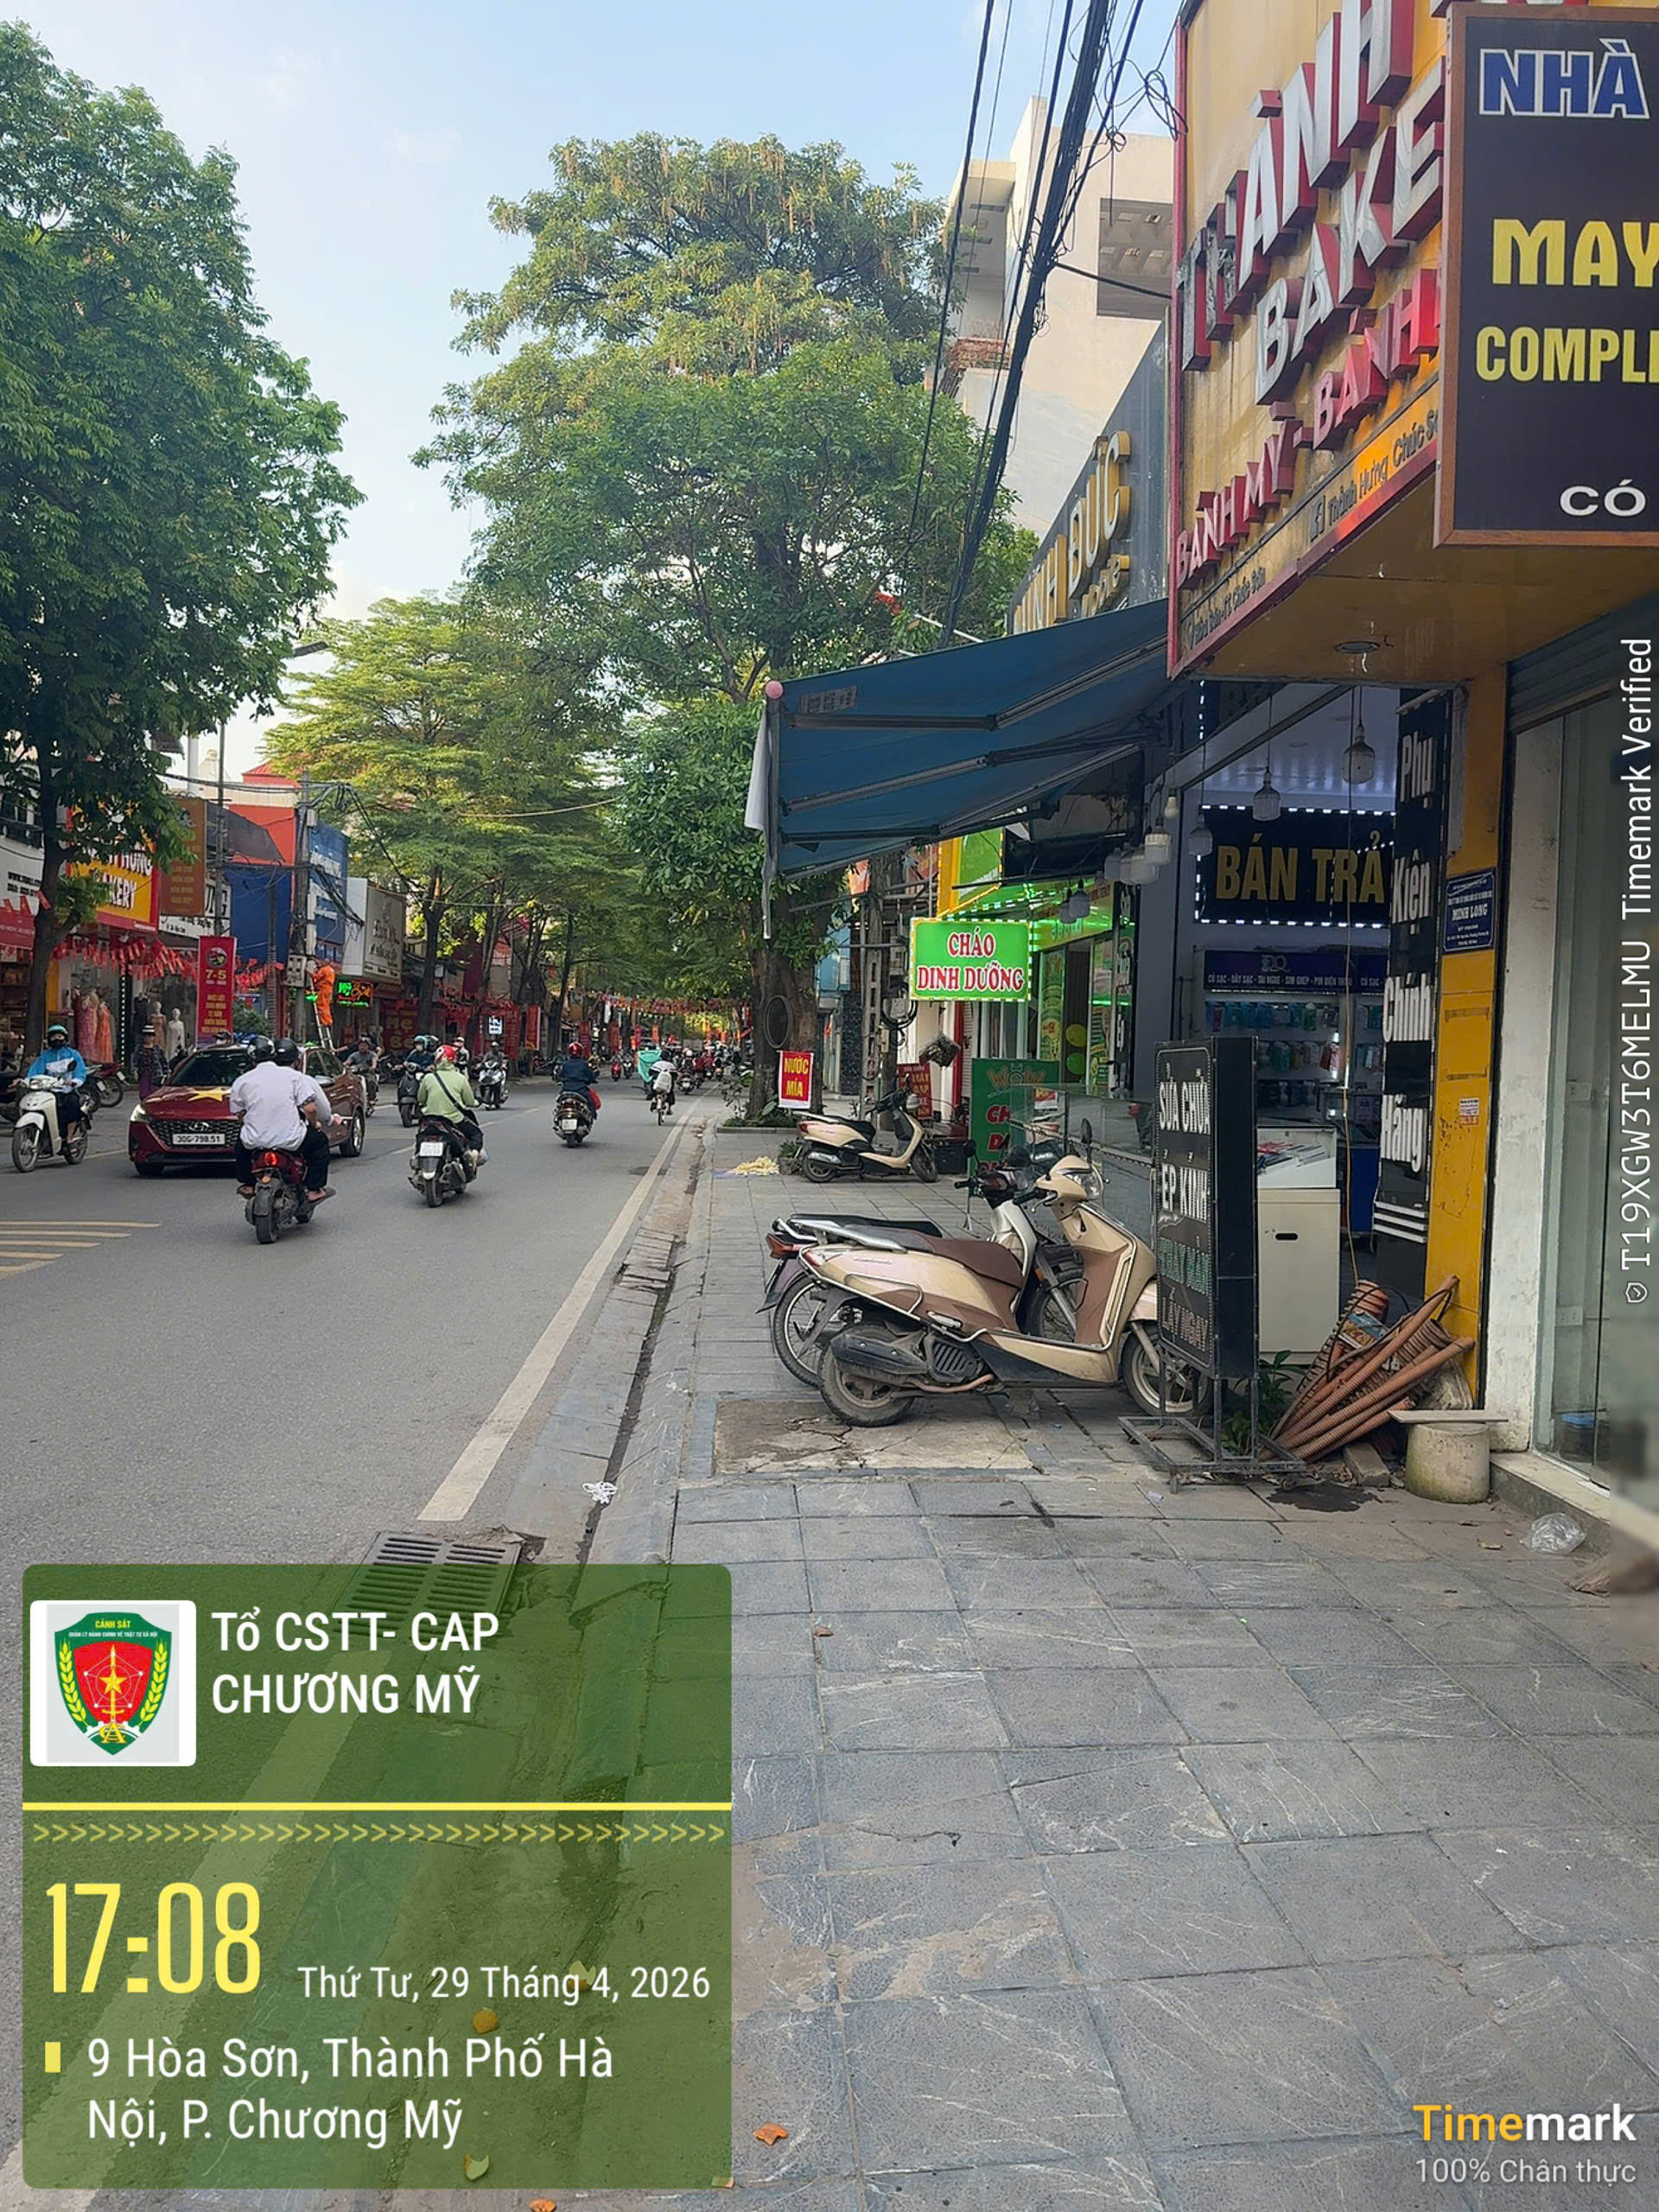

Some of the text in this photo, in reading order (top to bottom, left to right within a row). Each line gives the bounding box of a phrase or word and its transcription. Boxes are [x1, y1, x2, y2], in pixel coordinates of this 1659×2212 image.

[1478, 38, 1649, 119] NHÀ
[1492, 219, 1659, 288] MAY
[1177, 477, 1246, 589] BÁNH
[1313, 270, 1438, 450] BÁNH
[1359, 454, 1389, 499] Hưng
[1393, 422, 1425, 467] Chúc
[1559, 479, 1646, 517] CÓ
[1400, 731, 1435, 809] Phụ
[1216, 830, 1385, 903] BÁN TRẢ
[1391, 849, 1431, 936] Kiện
[916, 960, 1025, 992] DINH DƯỠNG
[947, 925, 995, 957] CHÁO
[1383, 973, 1432, 1043] Chính
[784, 1055, 809, 1075] NƯỚC
[786, 1077, 803, 1097] MÍA
[1160, 1063, 1210, 1135] SỬA CHỮA
[1381, 1094, 1424, 1173] Hãng
[1179, 1152, 1208, 1224] KÍNH
